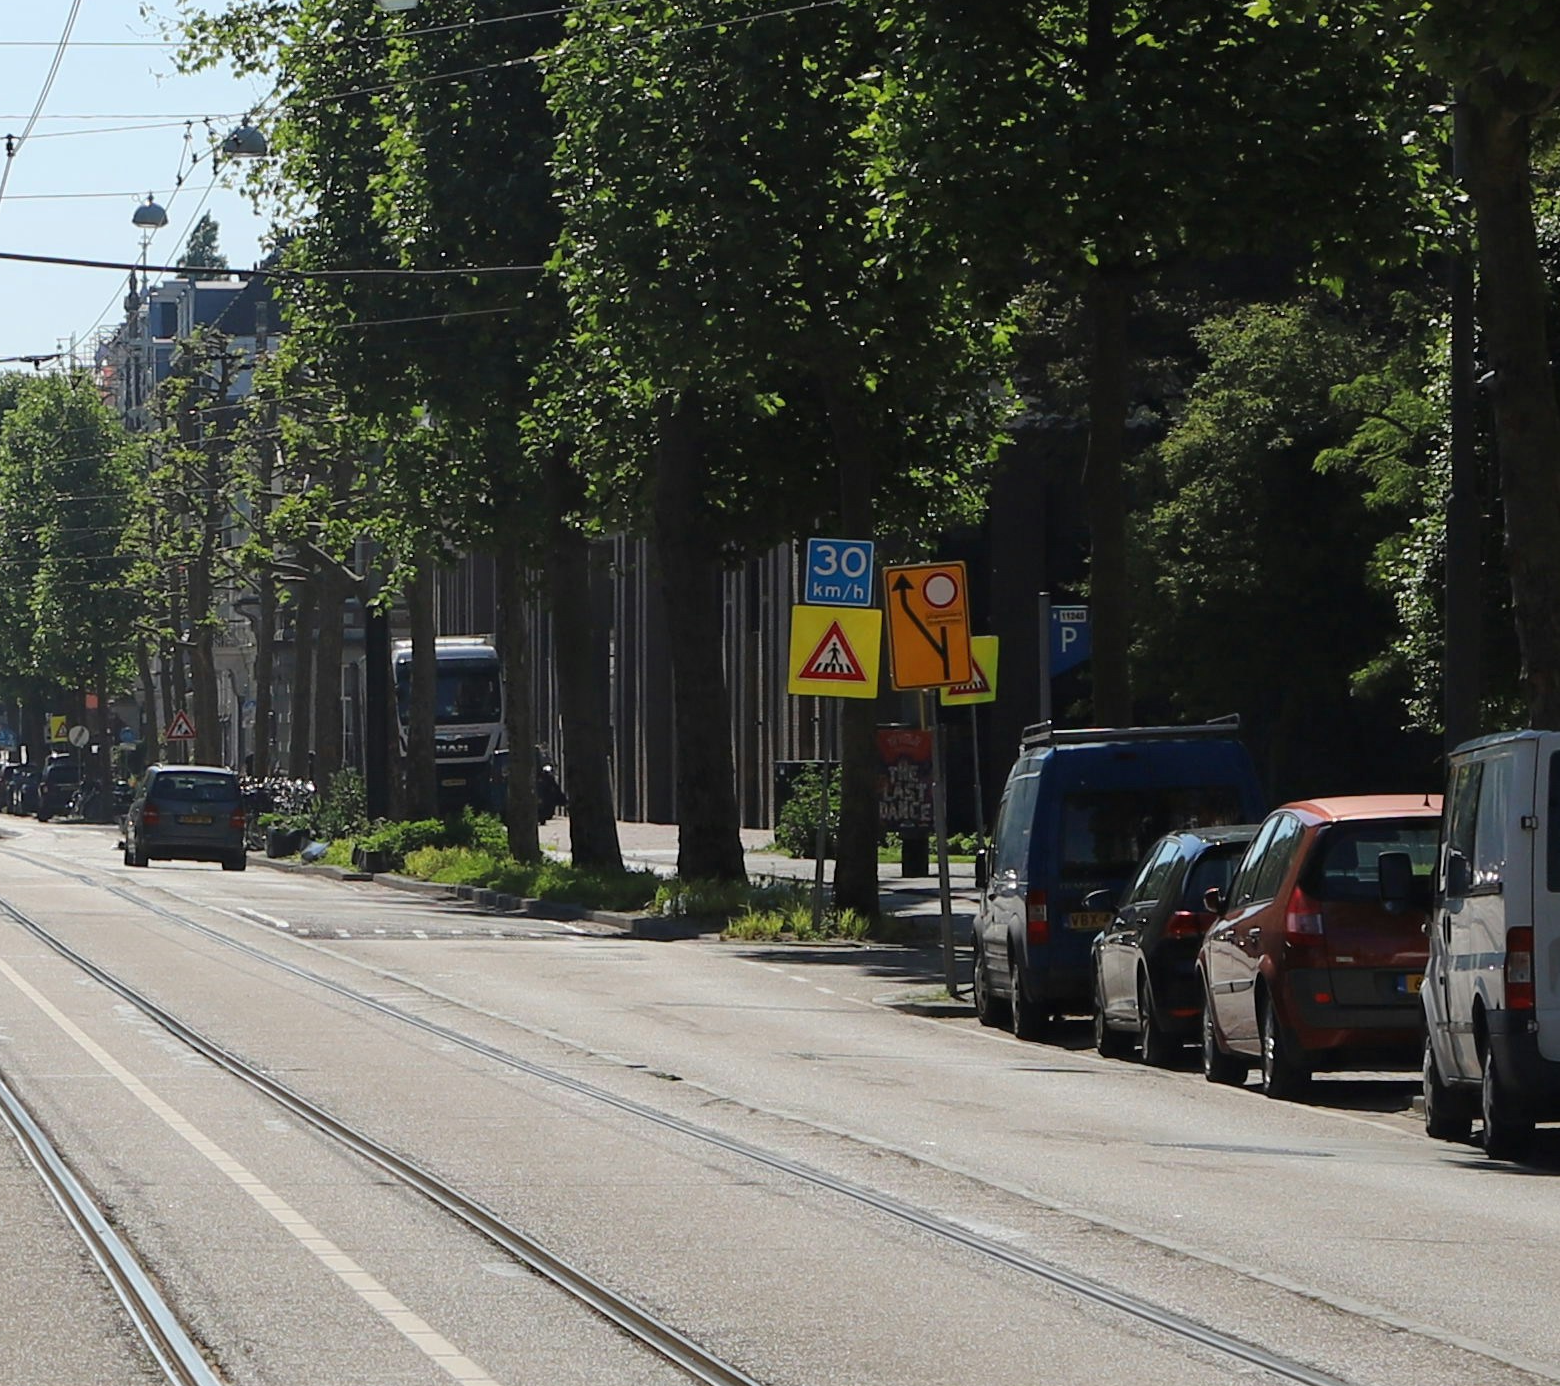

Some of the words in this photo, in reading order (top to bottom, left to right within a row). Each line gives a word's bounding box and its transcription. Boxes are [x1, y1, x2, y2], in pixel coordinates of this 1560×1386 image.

[813, 545, 867, 578] 30
[813, 582, 864, 601] km/h
[1061, 626, 1078, 653] P
